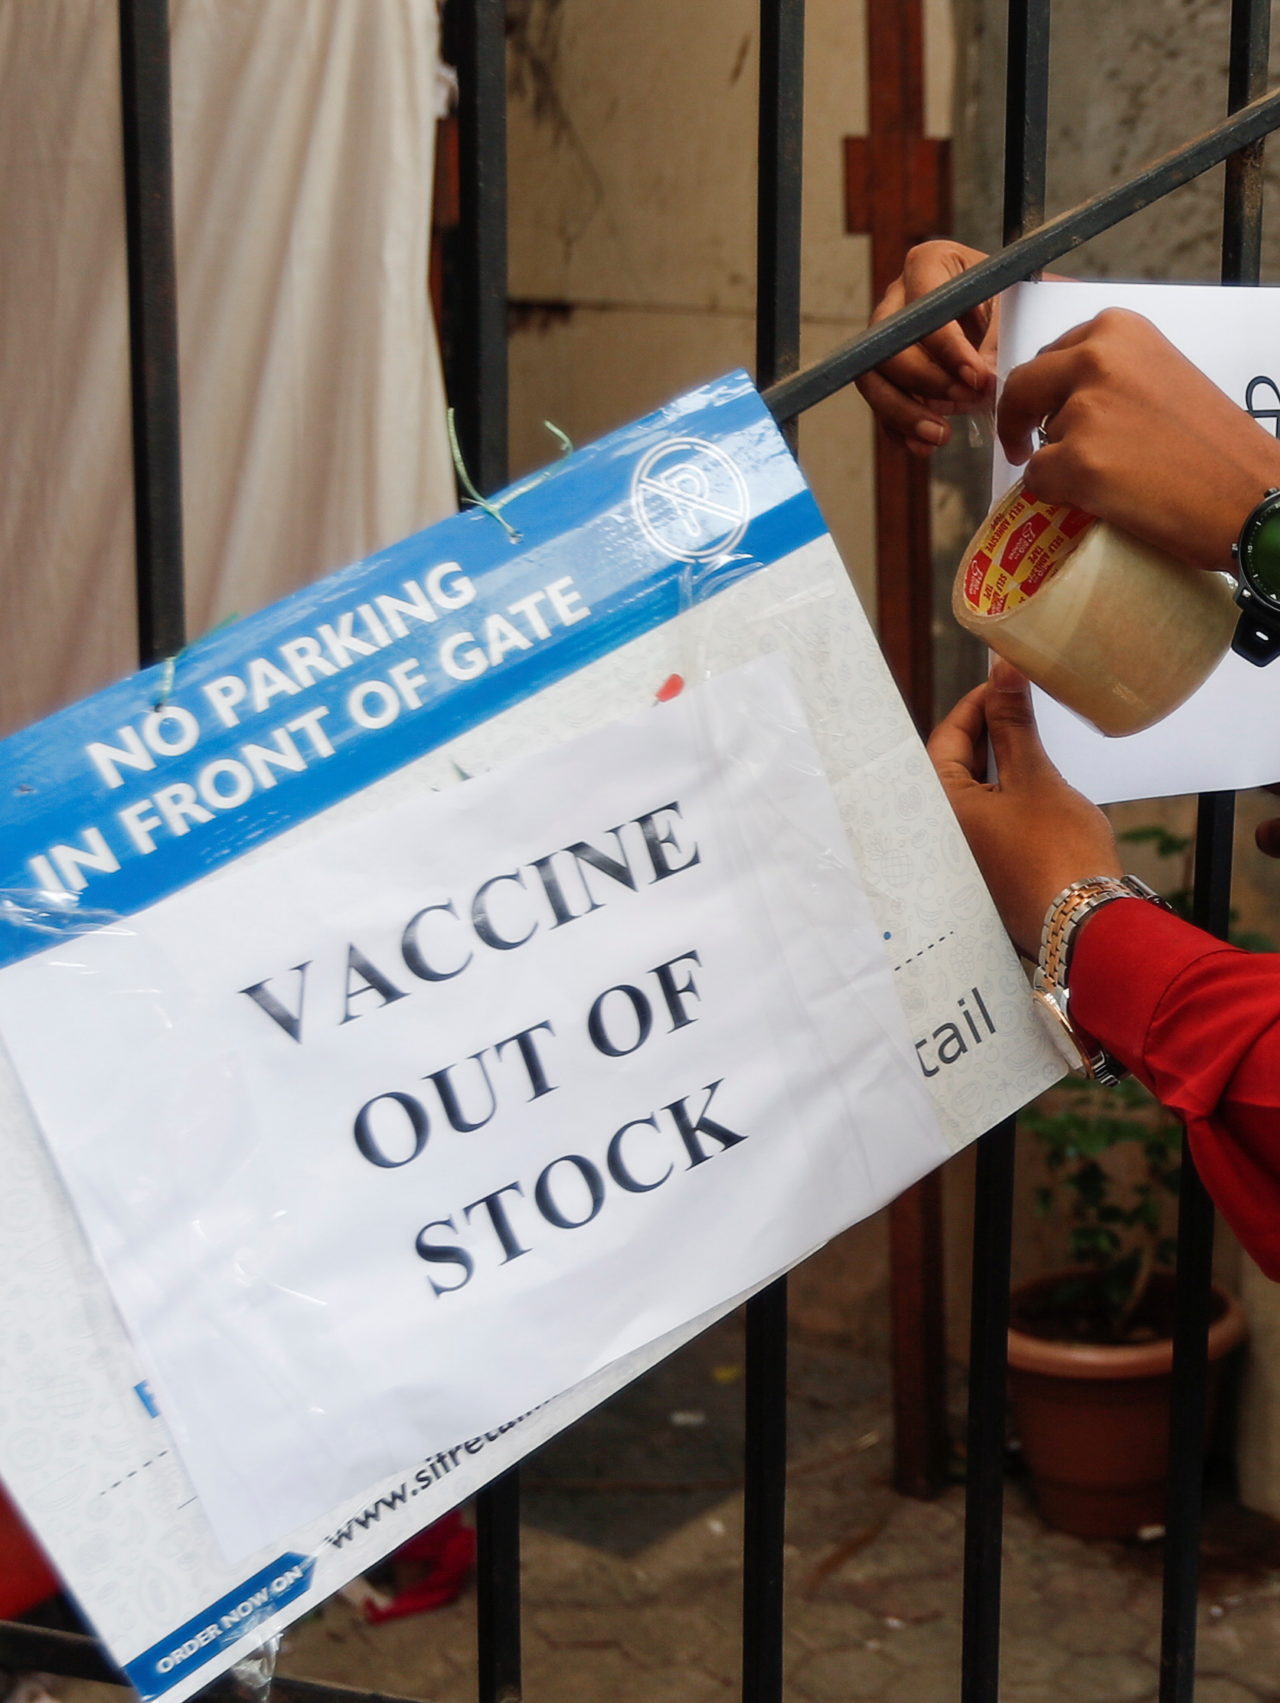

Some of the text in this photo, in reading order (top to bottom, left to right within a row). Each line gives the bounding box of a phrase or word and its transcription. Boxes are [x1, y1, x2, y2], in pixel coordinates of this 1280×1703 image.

[985, 520, 1011, 554] ADHESIVE
[1010, 502, 1026, 522] SELF
[28, 575, 592, 892] IN FRONT OF GATE
[86, 561, 478, 788] NO PARKING
[238, 801, 702, 1045] VACCINE
[353, 950, 704, 1169] OUT OF
[414, 1078, 749, 1298] STOCK
[156, 1624, 223, 1674] ORDER
[220, 1587, 269, 1629] NOW
[270, 1565, 303, 1594] ON
